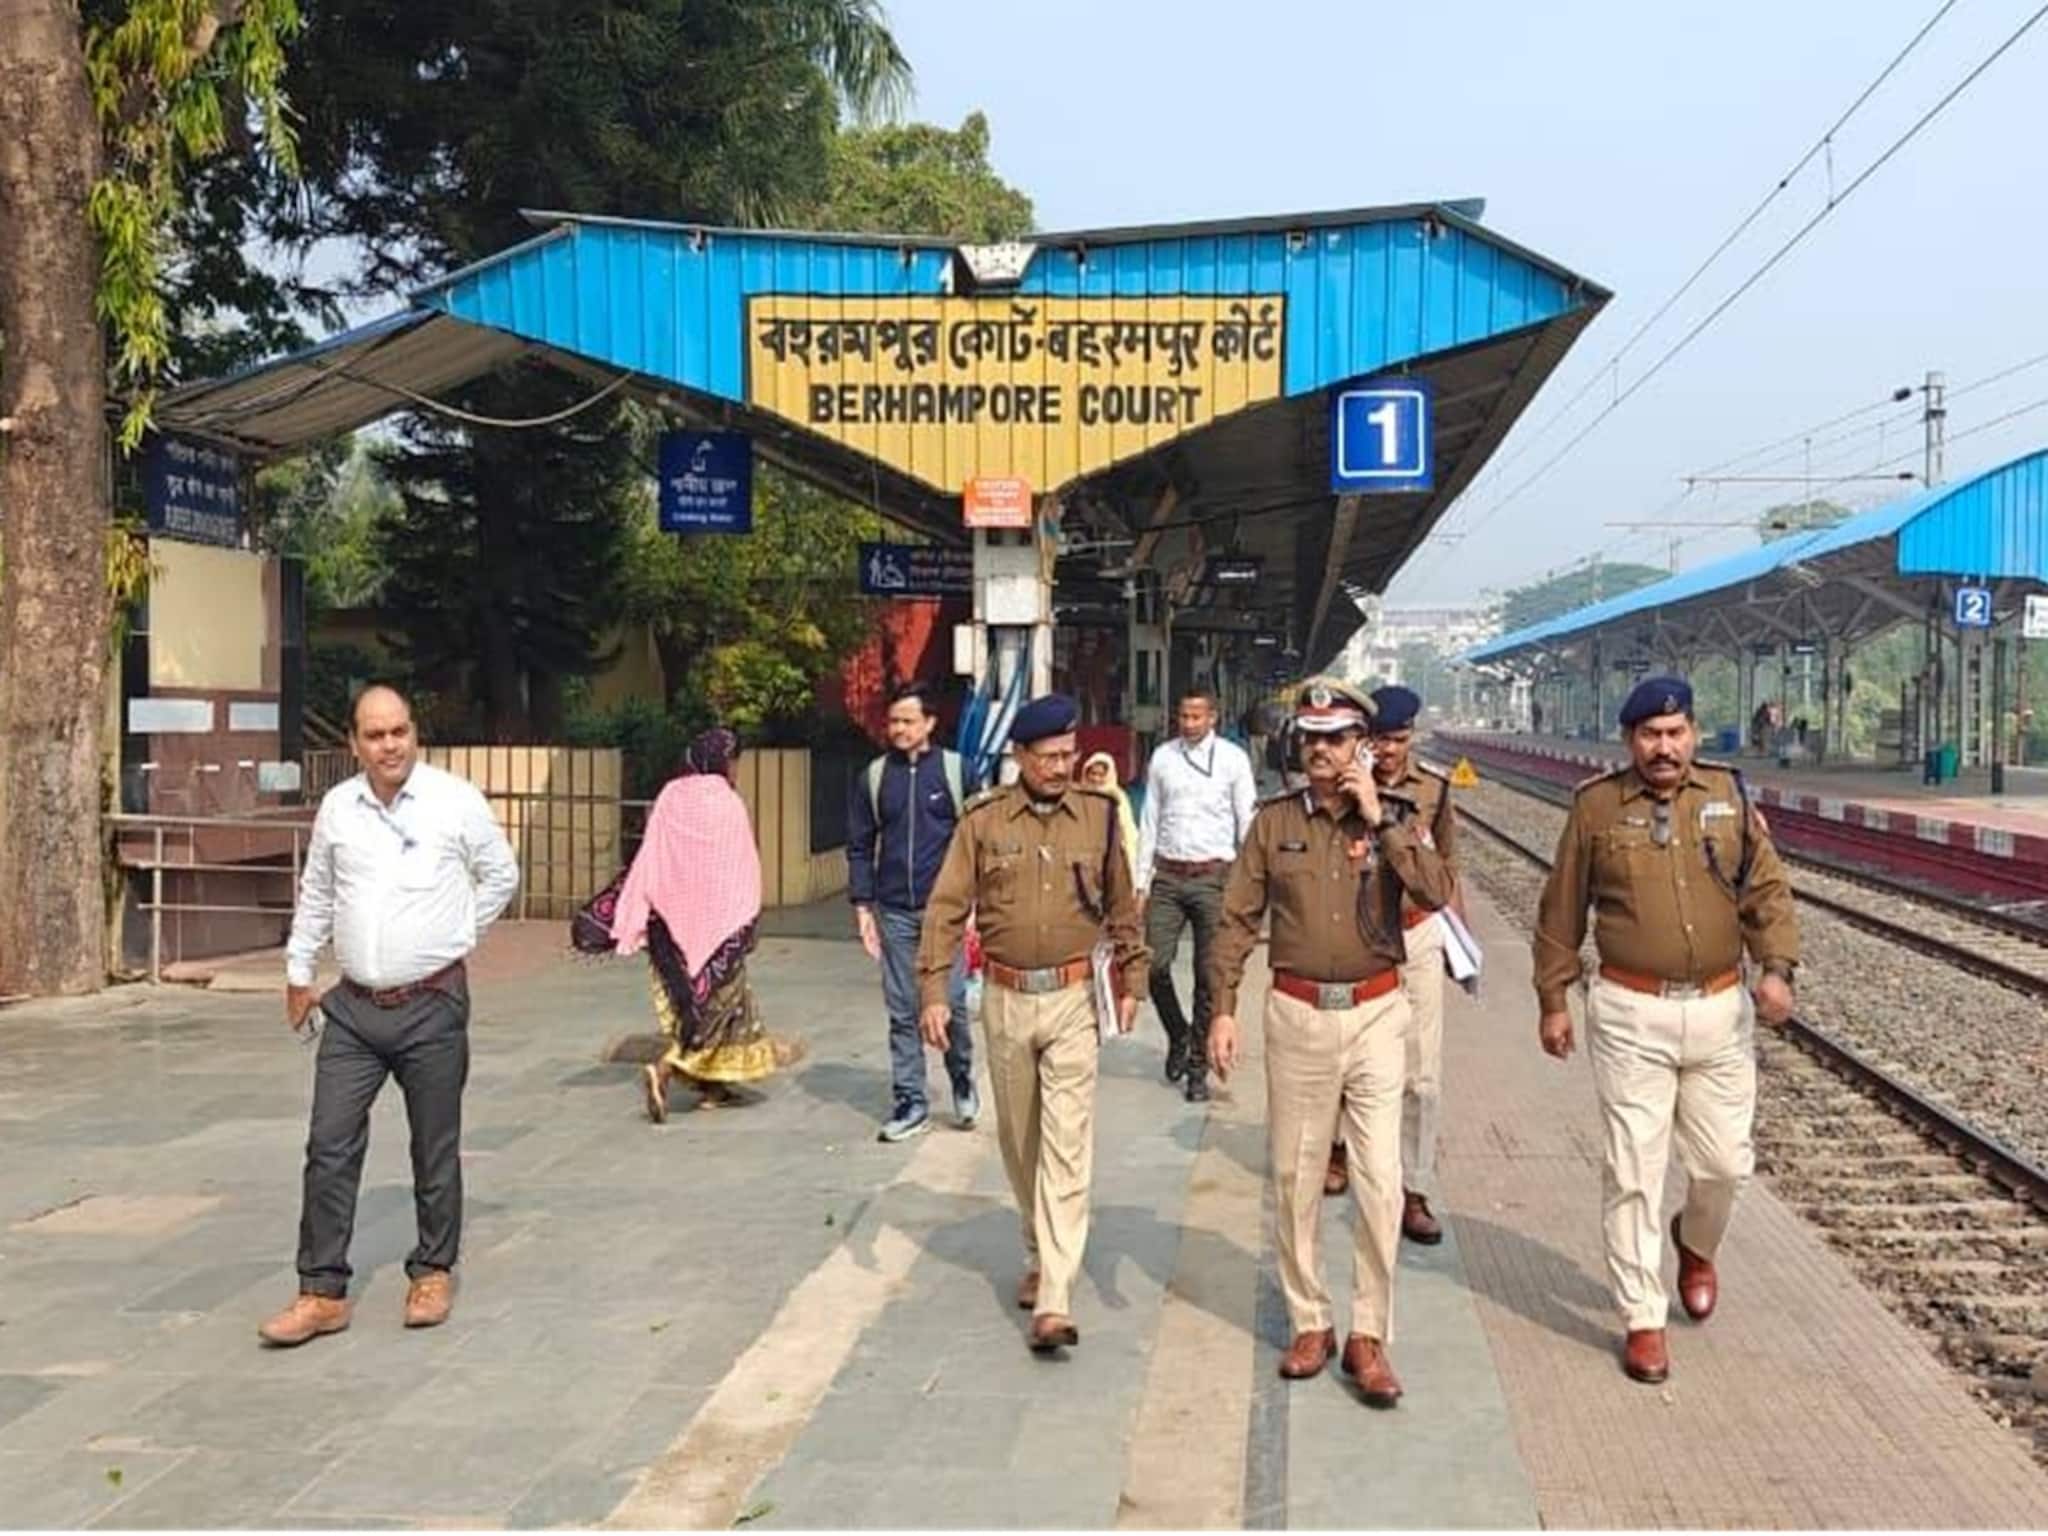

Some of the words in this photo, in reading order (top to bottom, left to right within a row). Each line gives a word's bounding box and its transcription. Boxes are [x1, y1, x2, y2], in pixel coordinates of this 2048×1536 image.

[757, 317, 942, 374] বহরমপুর
[1212, 302, 1278, 362] कोर्ट
[809, 382, 1061, 425] BERHAMPORE
[1079, 382, 1203, 426] COURT
[1367, 401, 1397, 465] 1
[1966, 594, 1984, 621] 2
